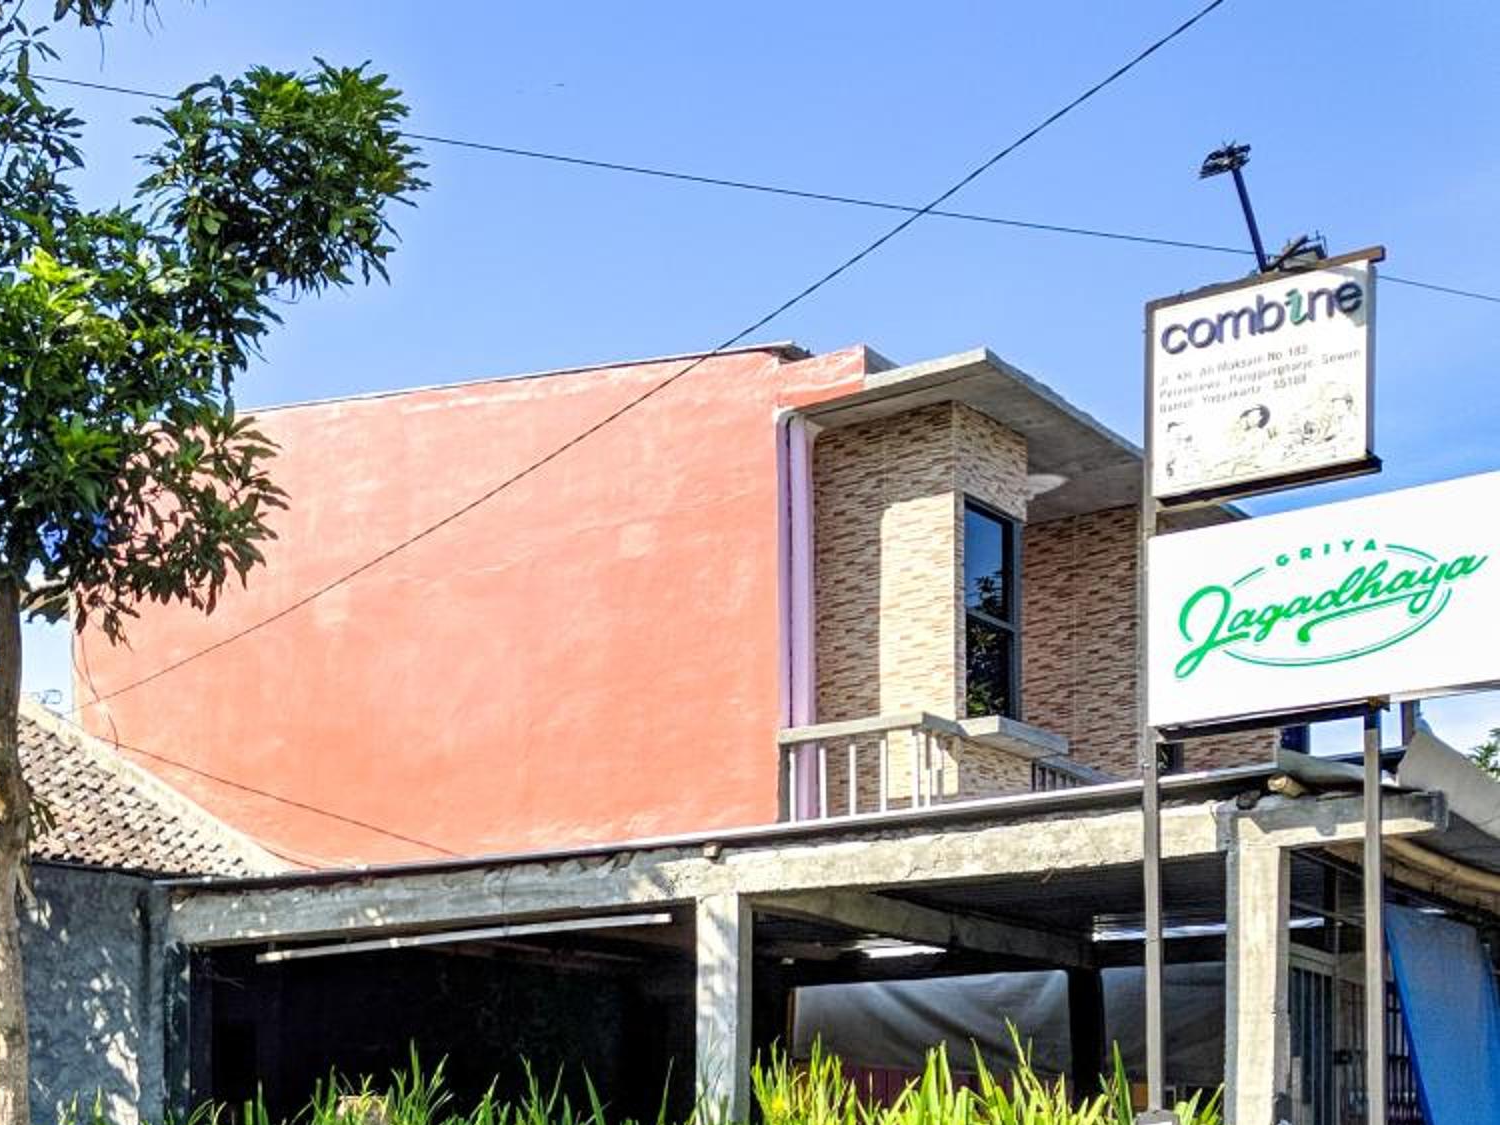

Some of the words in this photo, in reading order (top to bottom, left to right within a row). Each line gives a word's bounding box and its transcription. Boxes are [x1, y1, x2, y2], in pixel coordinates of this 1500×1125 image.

[1161, 280, 1362, 355] combine
[1275, 538, 1377, 567] GRIYA
[1174, 556, 1489, 679] Jagadhaya
